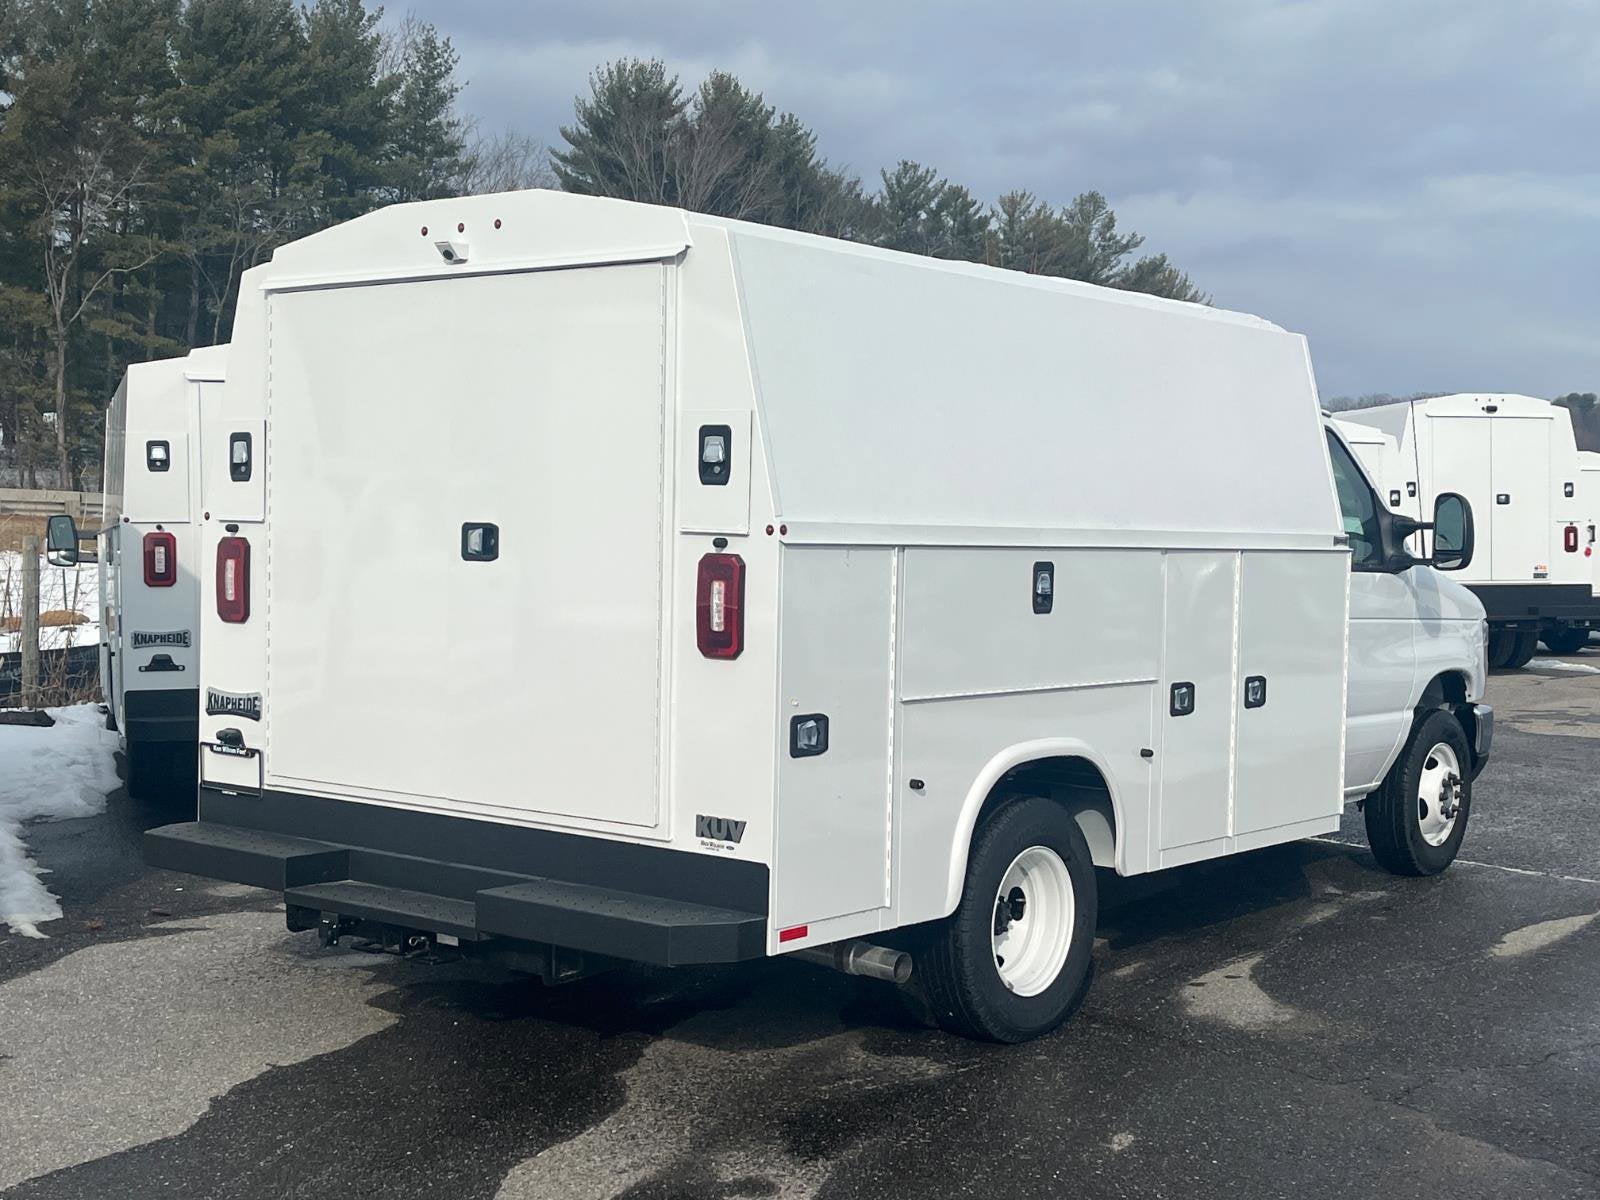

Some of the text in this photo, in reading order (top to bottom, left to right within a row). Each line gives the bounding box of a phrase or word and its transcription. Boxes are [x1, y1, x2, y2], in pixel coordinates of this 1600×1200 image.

[133, 631, 189, 646] KNAPHEIDE
[207, 690, 260, 713] KNAPHEIDE
[696, 814, 747, 843] KUV
